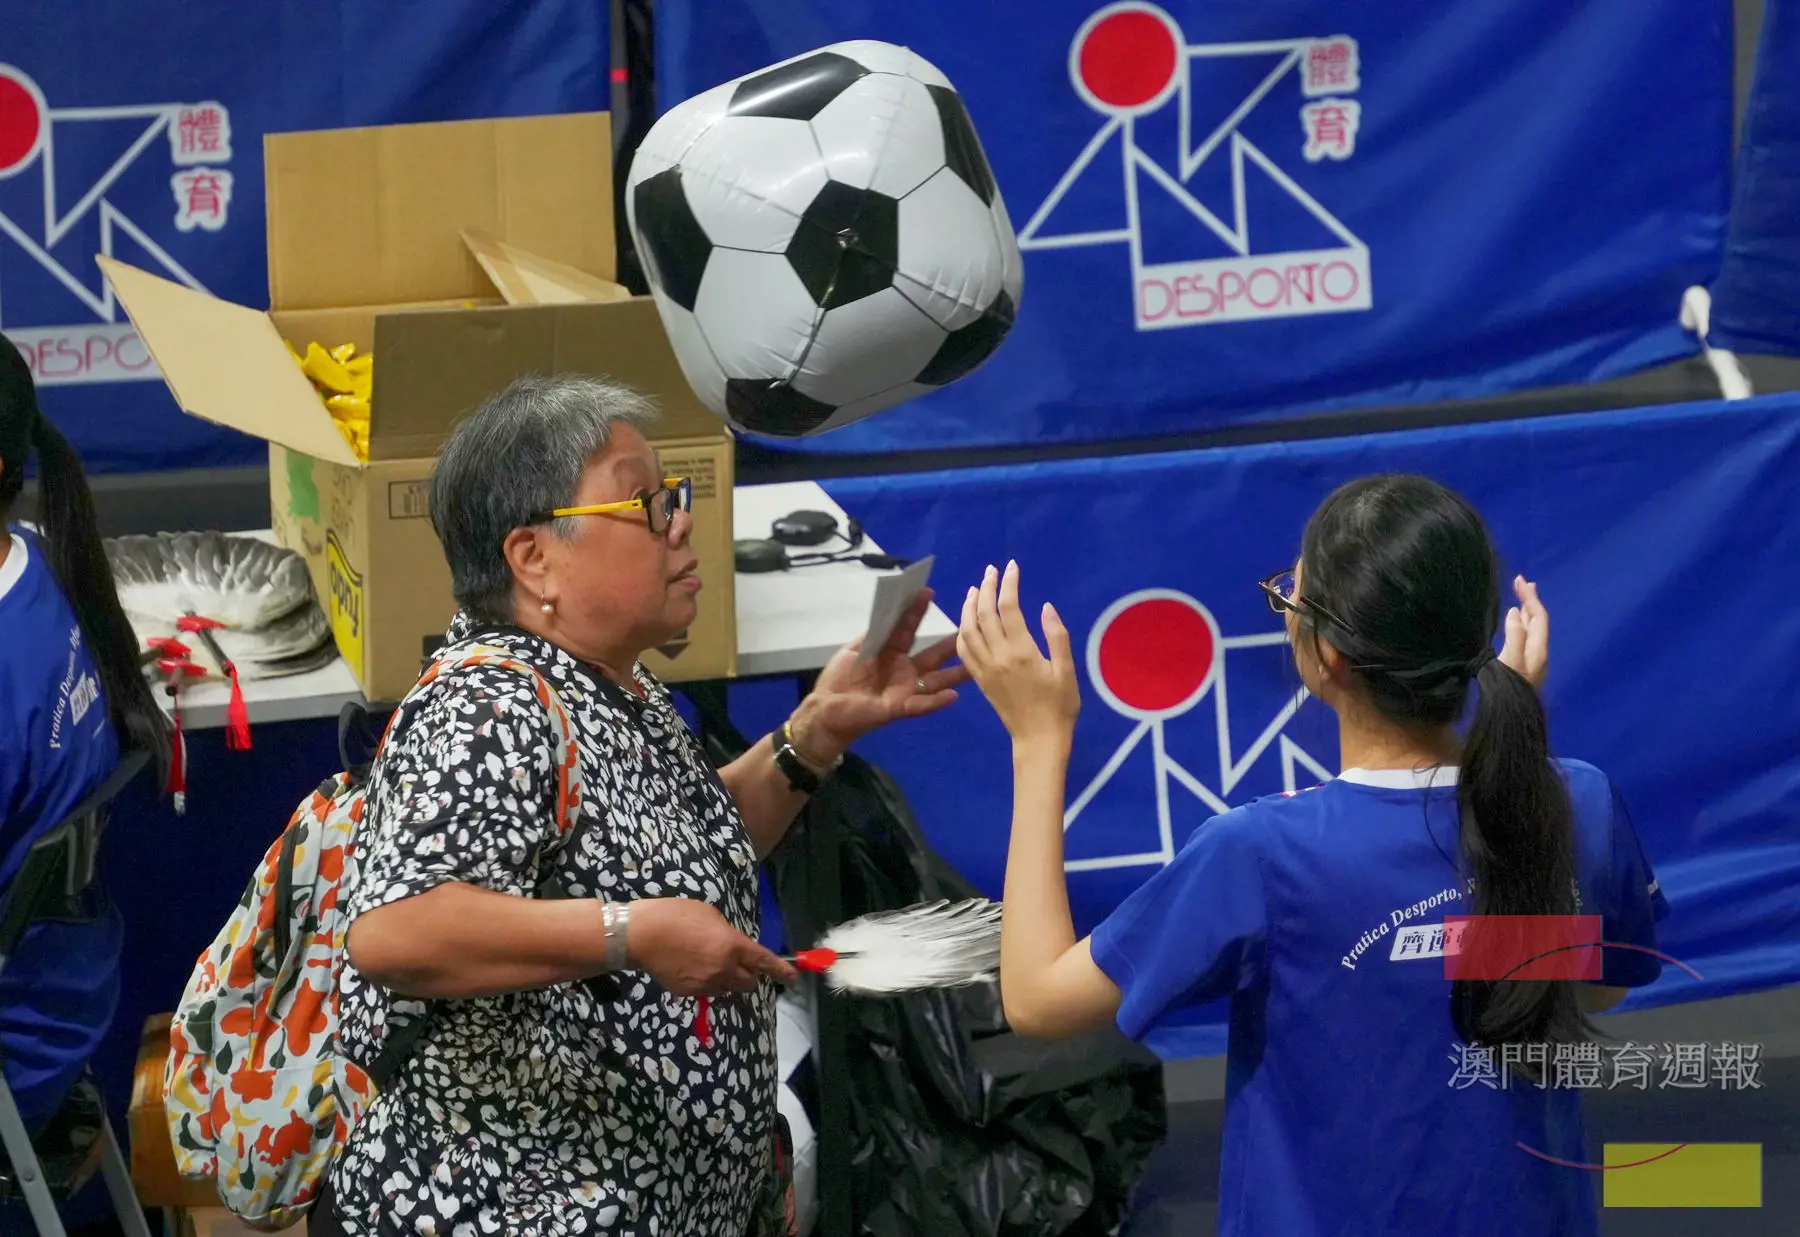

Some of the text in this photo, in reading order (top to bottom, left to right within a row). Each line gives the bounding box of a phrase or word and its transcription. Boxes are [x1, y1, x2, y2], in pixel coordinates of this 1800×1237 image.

[1307, 41, 1352, 152] 體育
[177, 106, 224, 219] 體育
[1139, 260, 1360, 322] DESPORTO
[13, 332, 152, 378] DESPO
[1341, 888, 1463, 970] Pratica Desporto,
[1400, 930, 1464, 956] 齊運
